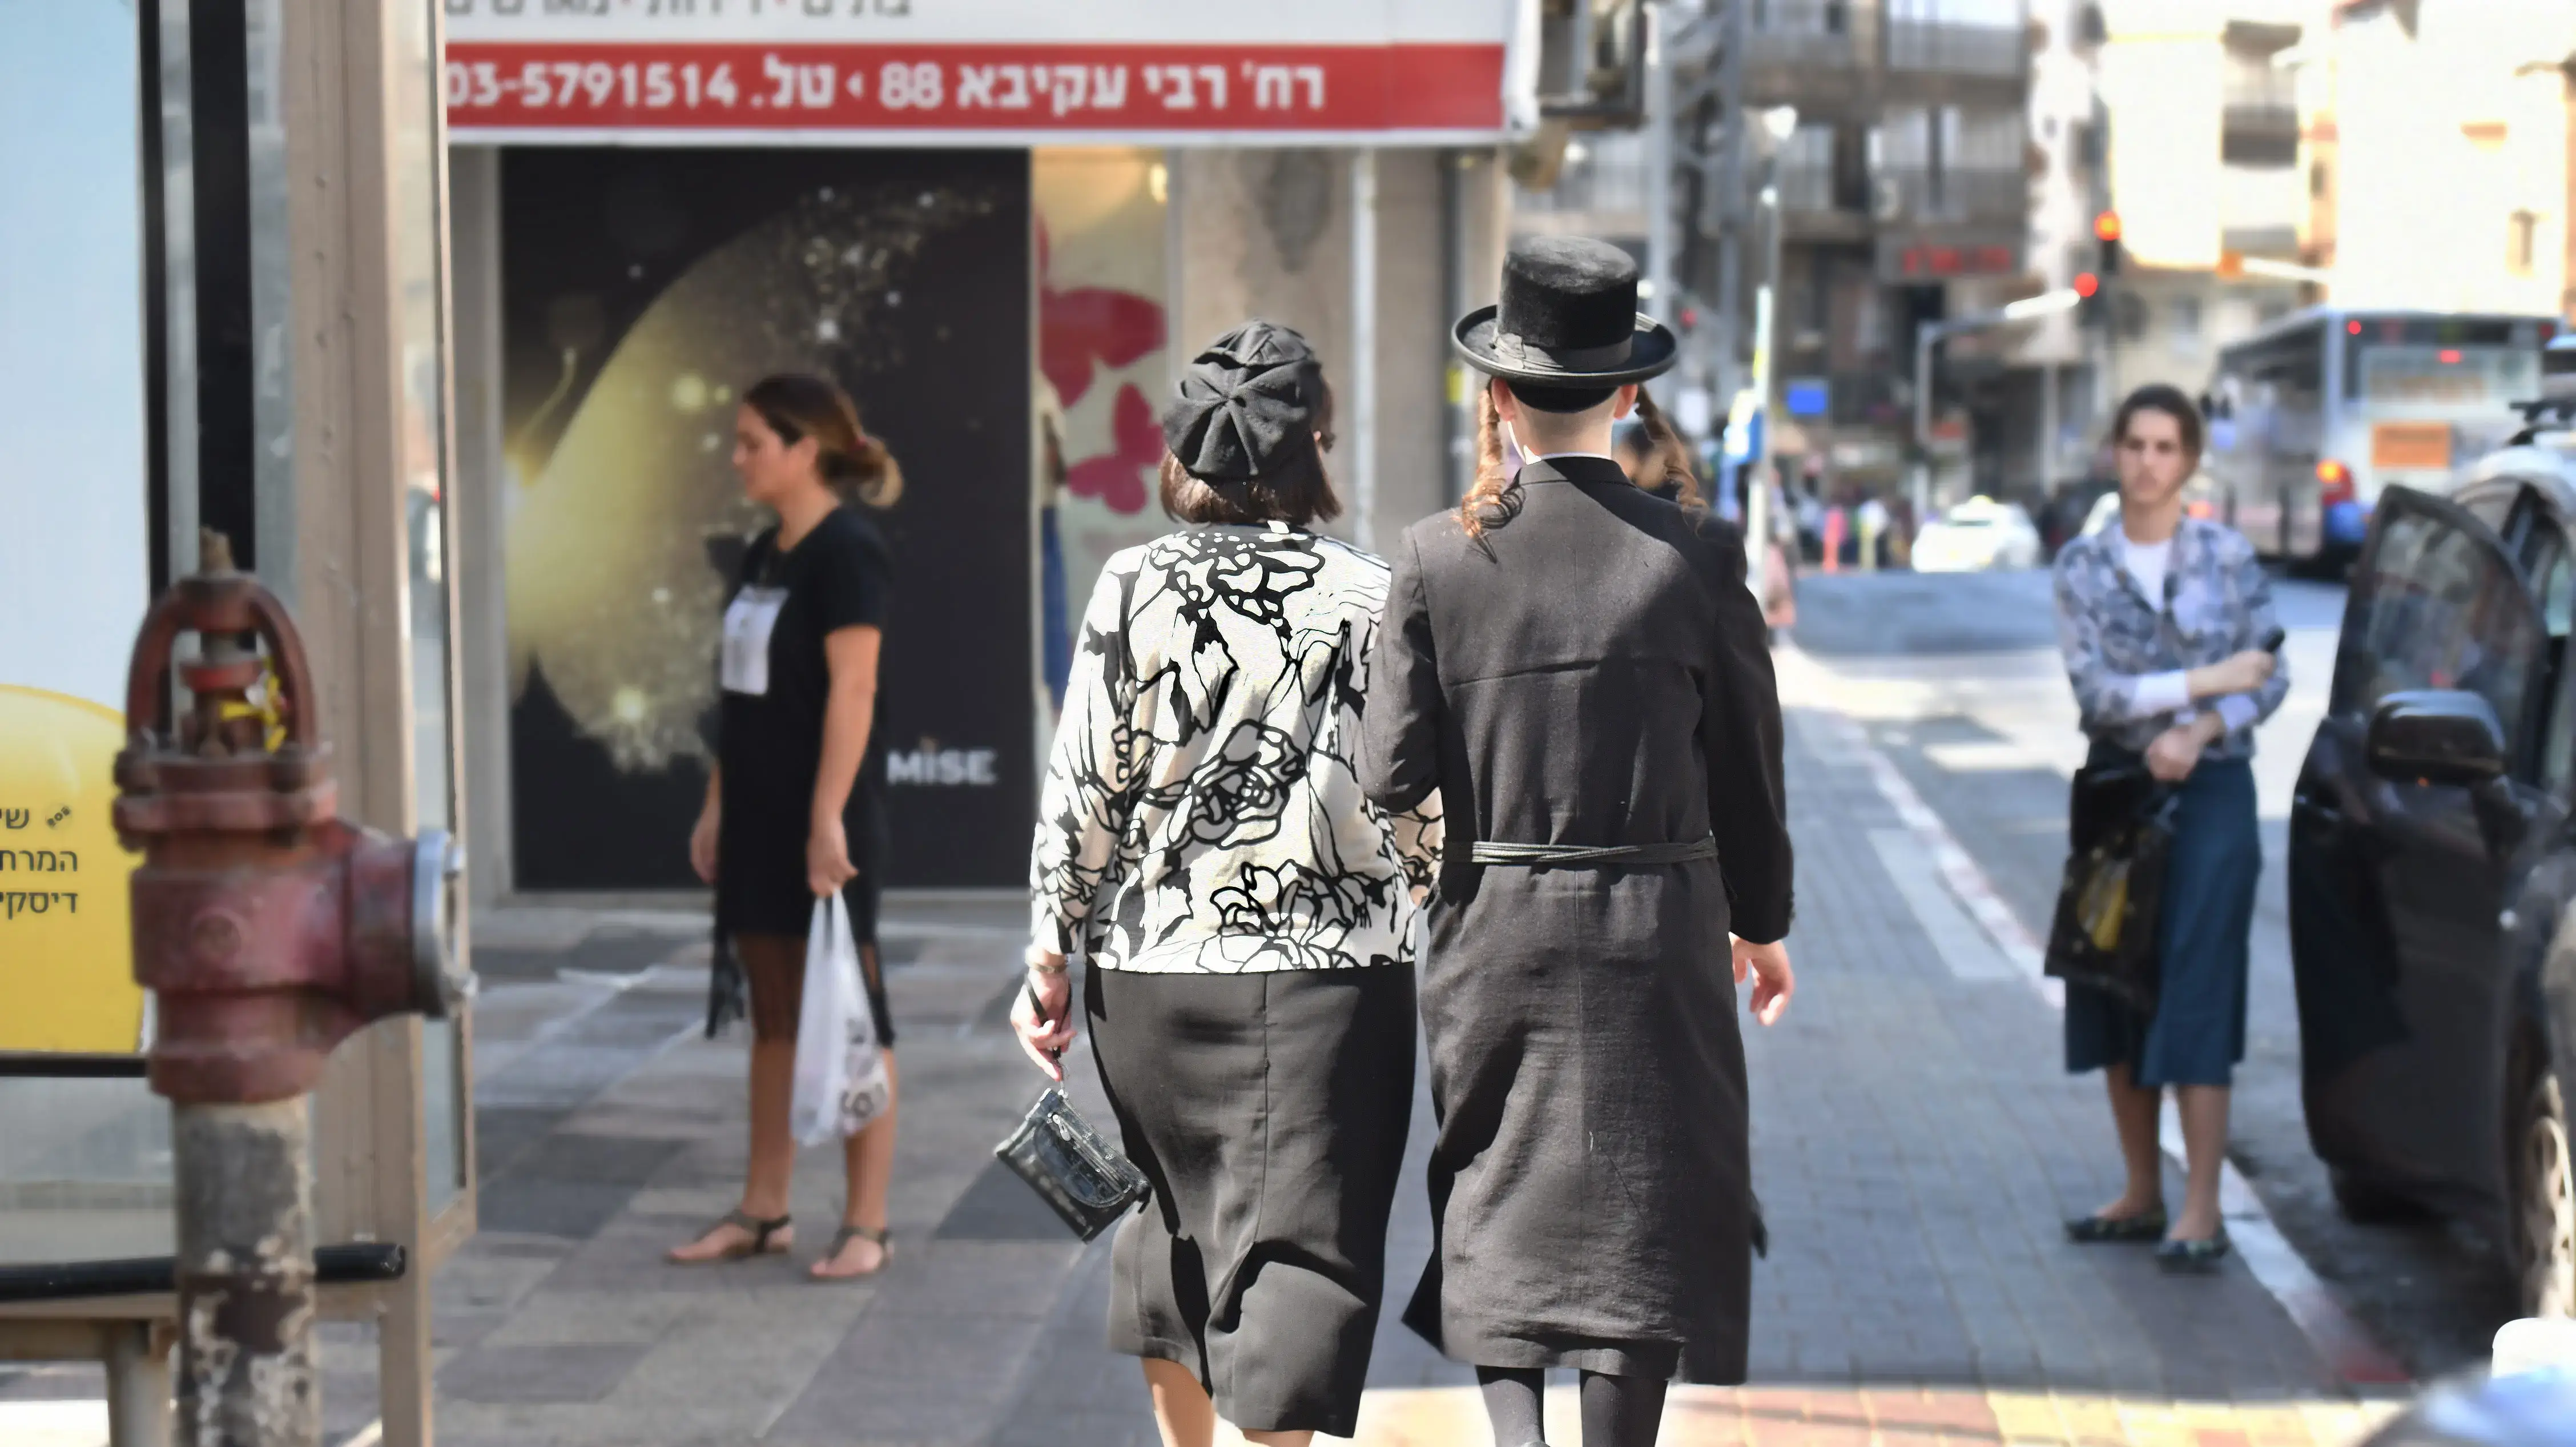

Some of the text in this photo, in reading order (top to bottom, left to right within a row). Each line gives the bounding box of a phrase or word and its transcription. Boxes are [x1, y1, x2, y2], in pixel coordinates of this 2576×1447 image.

[445, 54, 1325, 116] רח' רבי עקיבא 88 טל. 03-5791514
